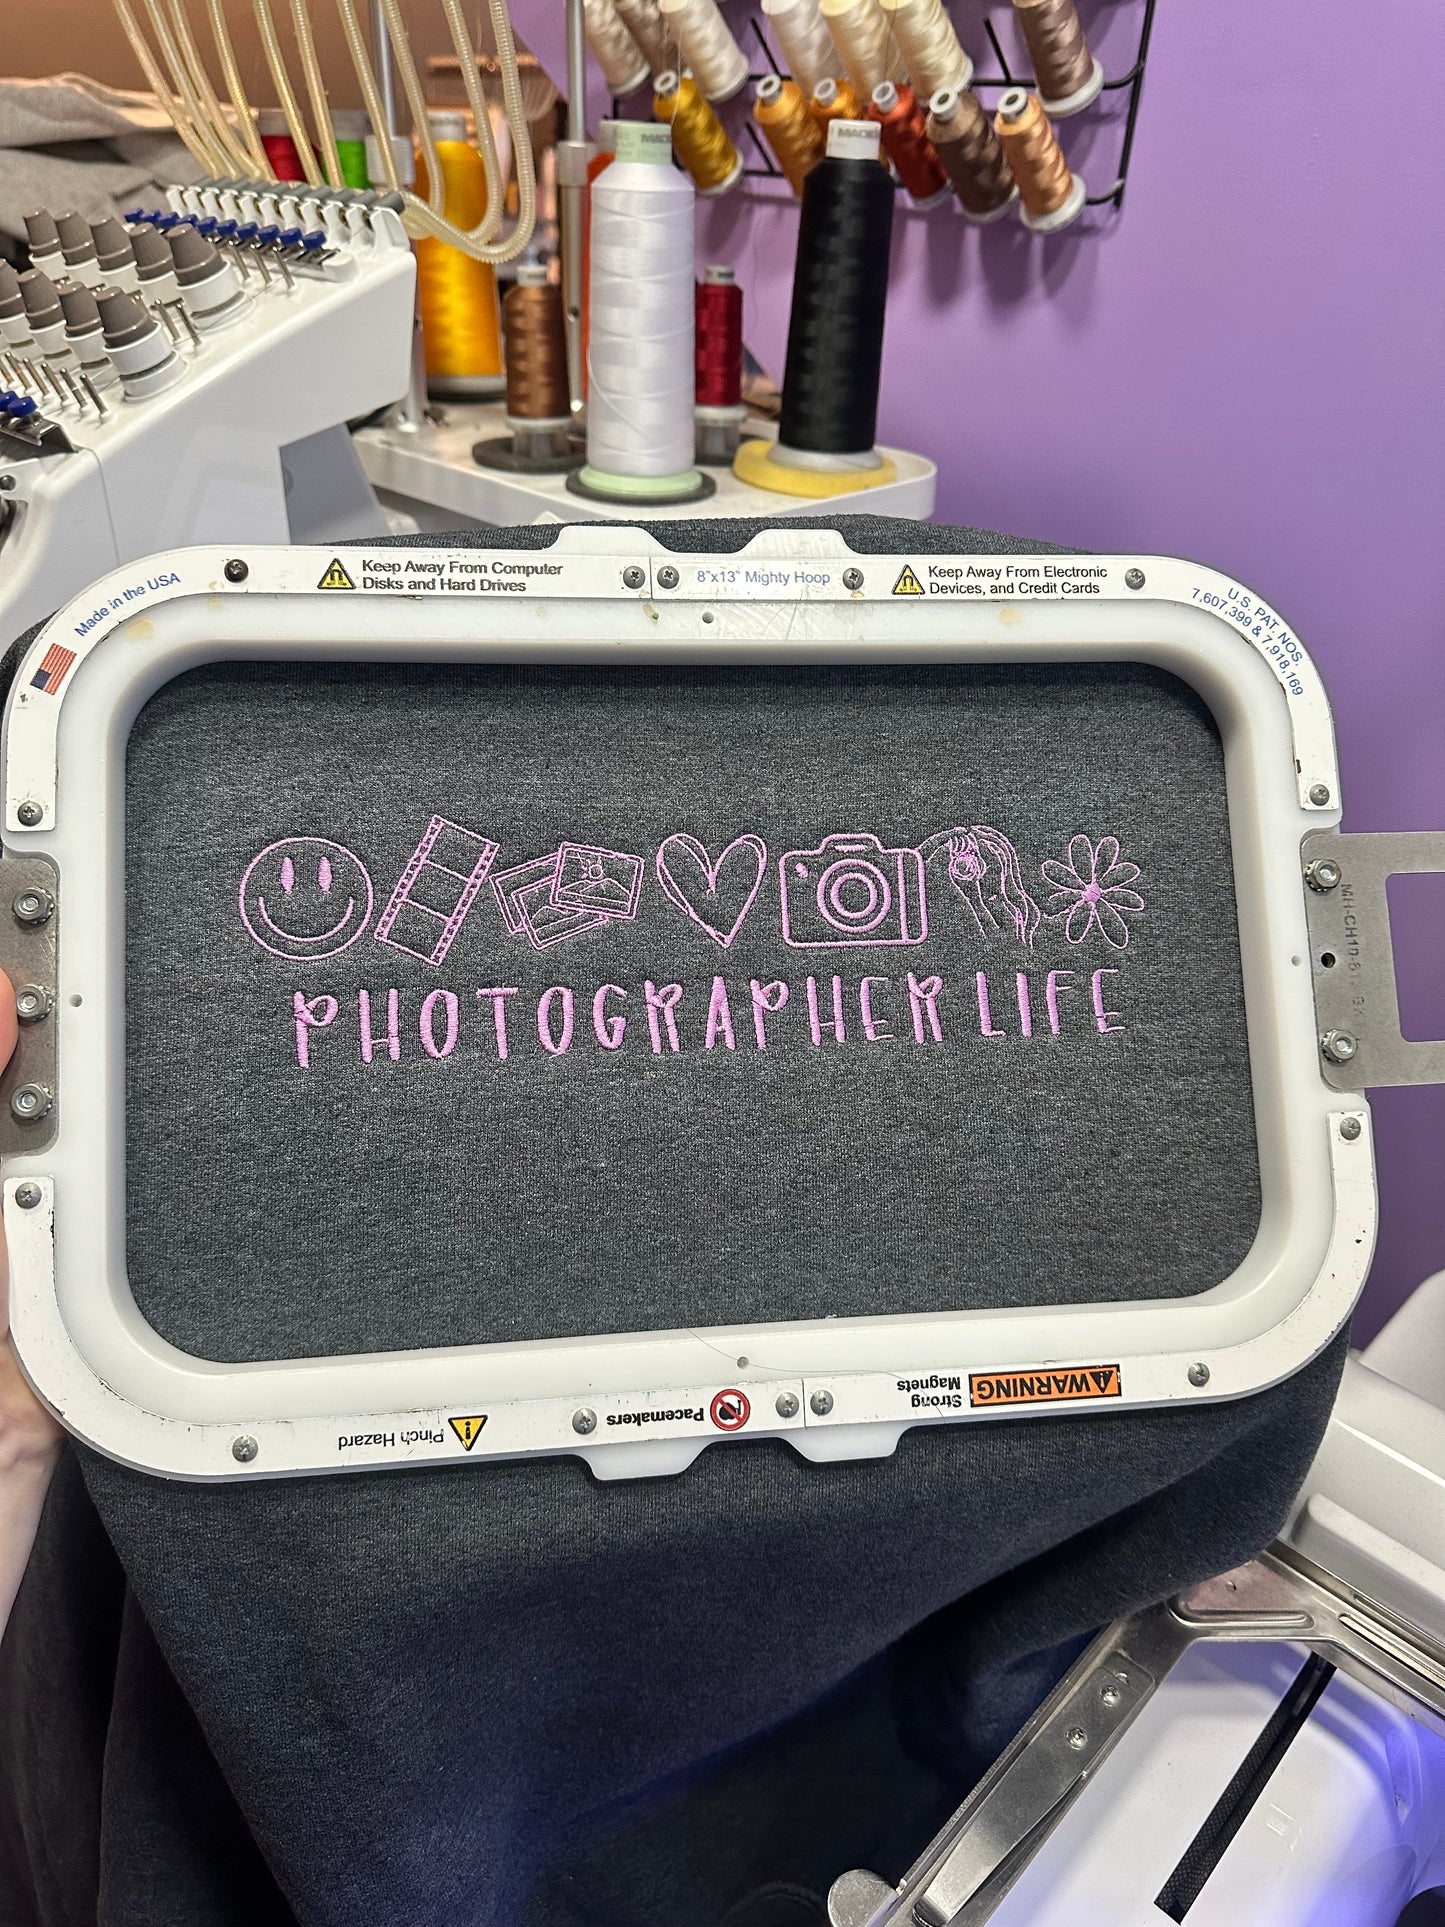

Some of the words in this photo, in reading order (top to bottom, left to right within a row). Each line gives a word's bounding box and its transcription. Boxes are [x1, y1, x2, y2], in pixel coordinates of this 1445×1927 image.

[362, 560, 401, 575] Keep
[405, 561, 446, 576] Away
[450, 561, 488, 574] From
[492, 562, 564, 577] Computer
[928, 566, 963, 580] Keep
[966, 567, 1001, 580] Away
[1006, 566, 1040, 578] From
[1044, 566, 1108, 578] Electronic
[363, 577, 404, 590] Disks
[408, 578, 436, 590] and
[440, 578, 476, 591] Hard
[480, 579, 527, 592] Drives
[745, 570, 790, 586] Mighty
[794, 571, 831, 585] Hoop
[929, 582, 986, 595] Devices,
[990, 582, 1014, 594] and
[1018, 582, 1057, 594] Credit
[1061, 582, 1100, 594] Cards
[74, 607, 110, 637] Made
[107, 598, 124, 609] in
[122, 586, 146, 601] the
[146, 572, 181, 591] USA
[1227, 587, 1251, 611] U.S.
[1254, 607, 1280, 634] PAT.
[1277, 632, 1303, 667] NOS.
[1192, 587, 1253, 628] 7,607,399
[1251, 625, 1262, 637] &
[1261, 634, 1304, 696] 7,918,169
[293, 968, 944, 1069] PHOTOGRAPHER
[976, 968, 1126, 1039] LIFE
[896, 1375, 961, 1393] Magnets
[976, 1373, 1091, 1399] WARNING
[910, 1394, 962, 1408] Strong
[606, 1407, 705, 1426] Pacemakers
[338, 1432, 395, 1450] Hazard
[400, 1428, 444, 1445] Pinch
